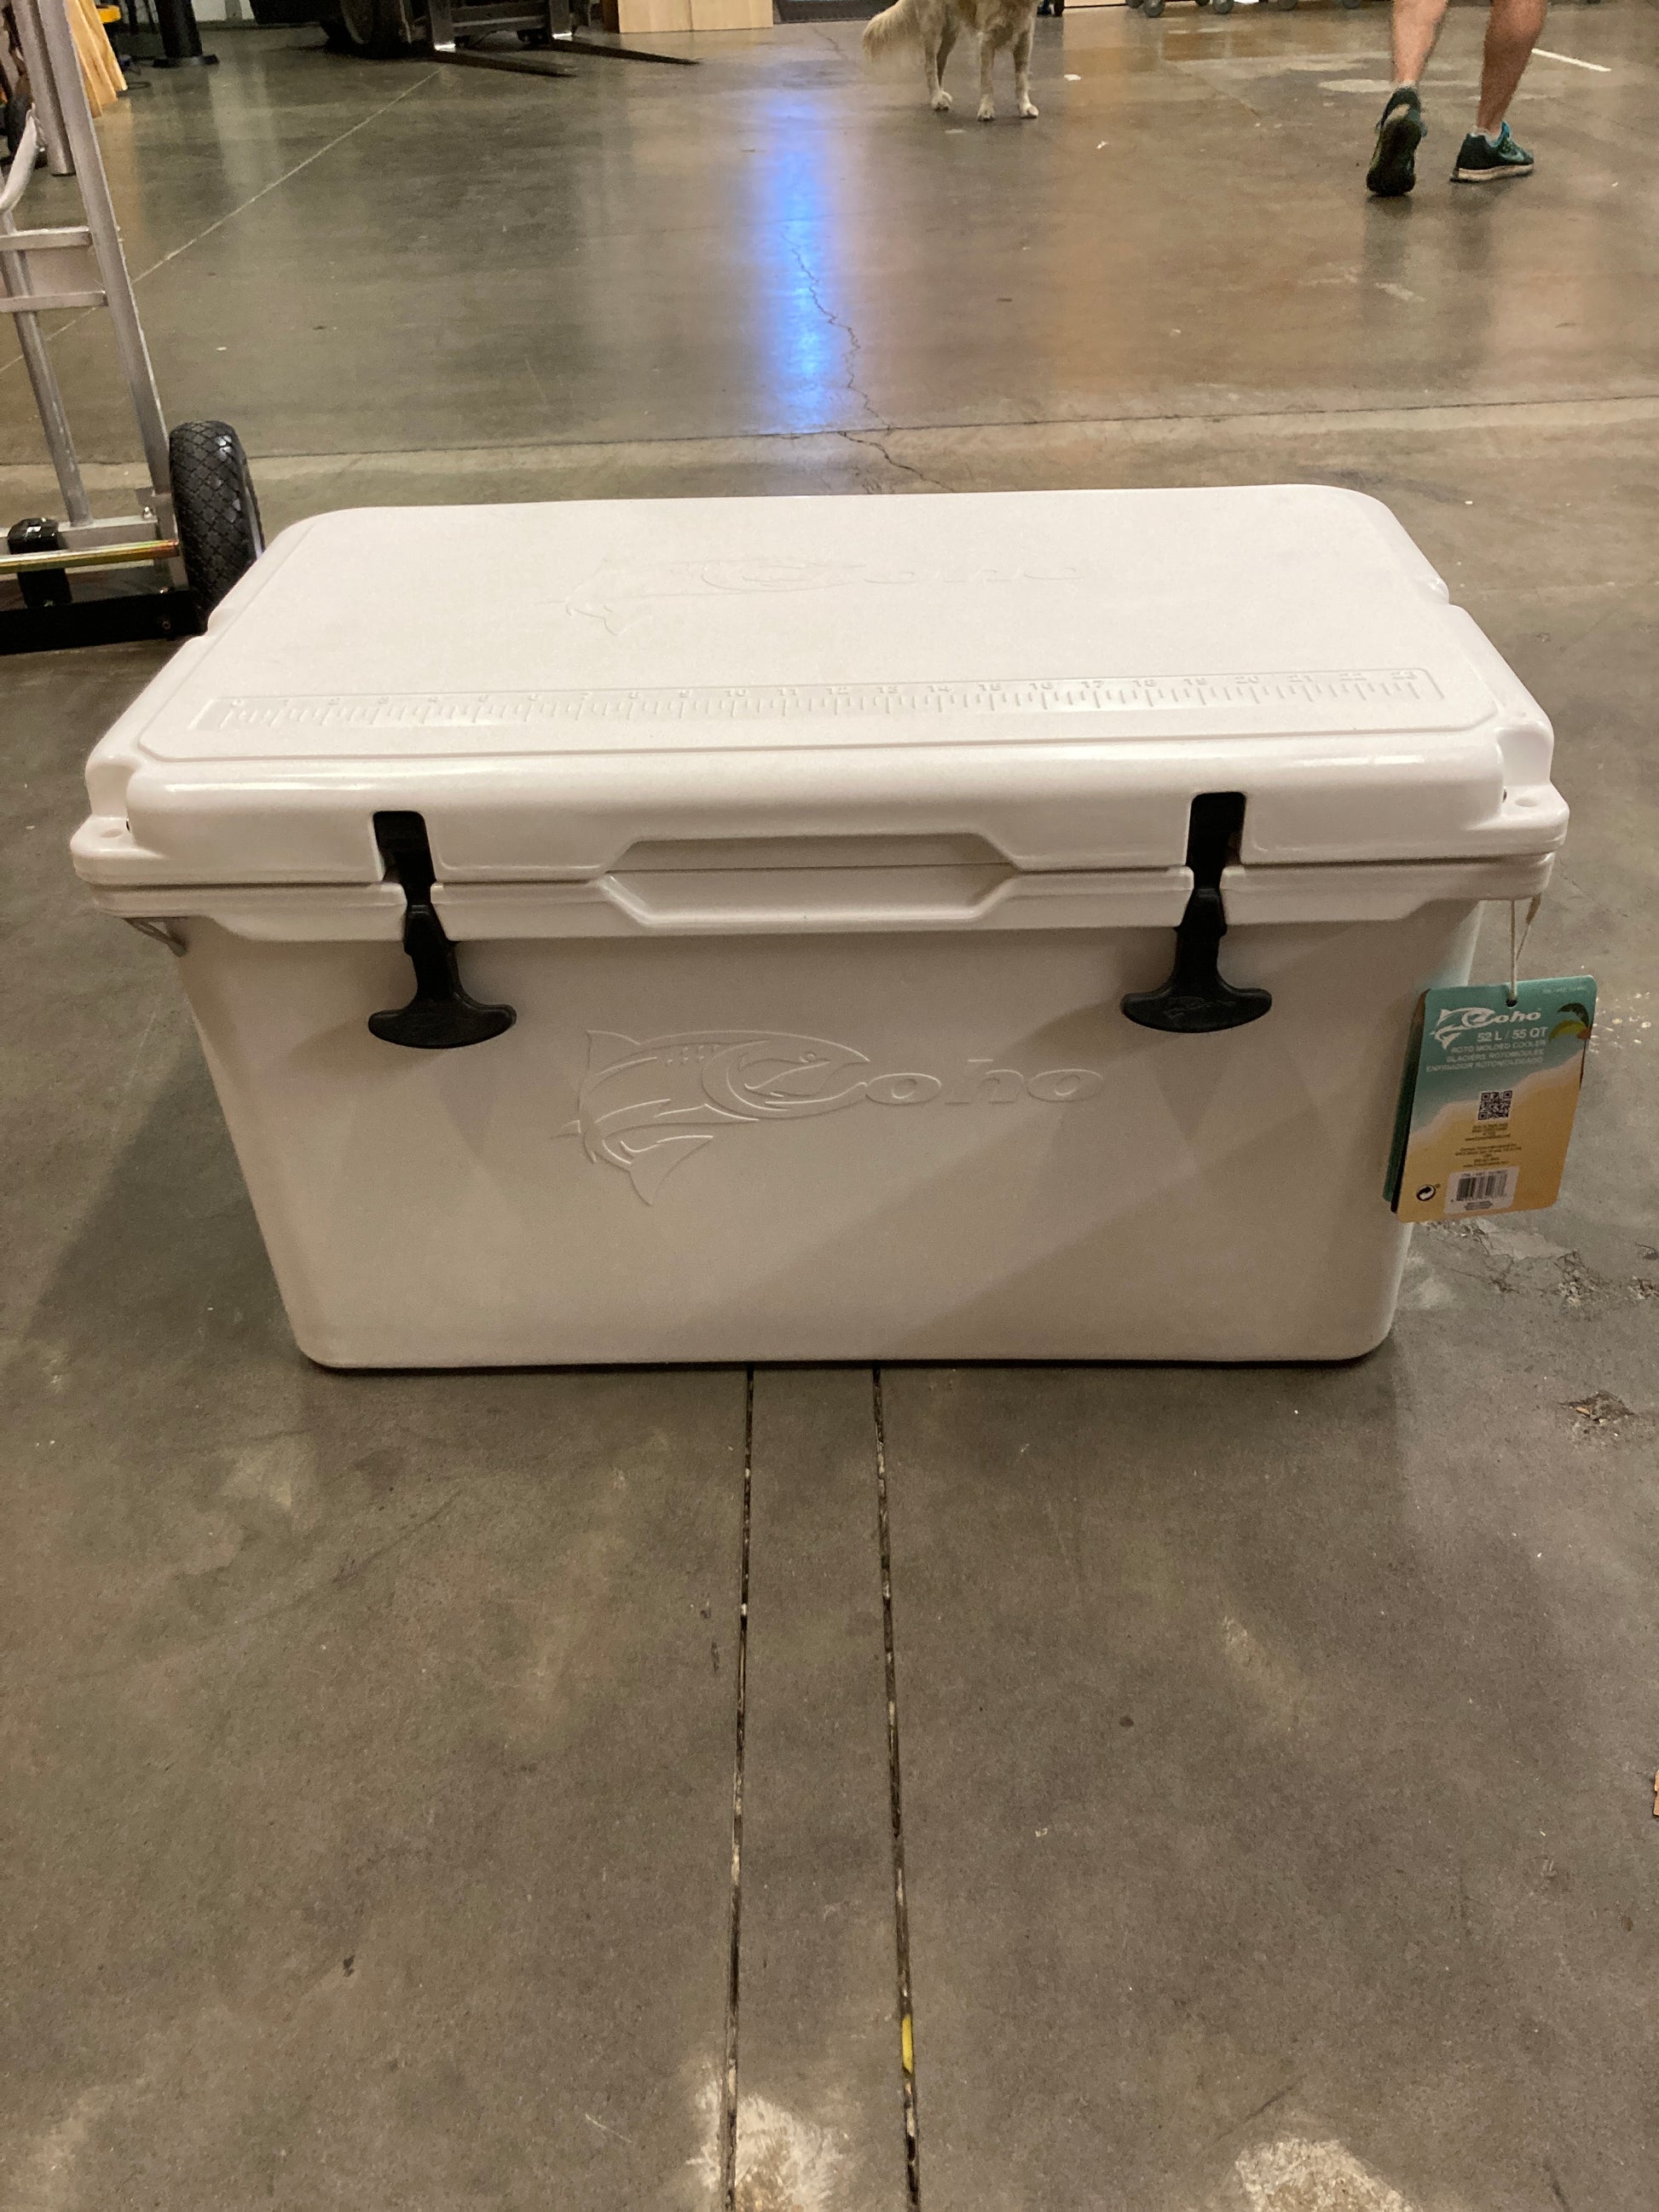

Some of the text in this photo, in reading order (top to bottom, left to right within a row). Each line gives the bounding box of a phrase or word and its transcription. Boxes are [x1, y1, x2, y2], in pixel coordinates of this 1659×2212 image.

[1081, 679, 1104, 689] 17
[1477, 1031, 1493, 1042] 52
[1494, 1031, 1503, 1041] L
[1512, 1029, 1527, 1039] 55
[1529, 1026, 1548, 1038] QT
[1513, 1039, 1547, 1048] COOLER
